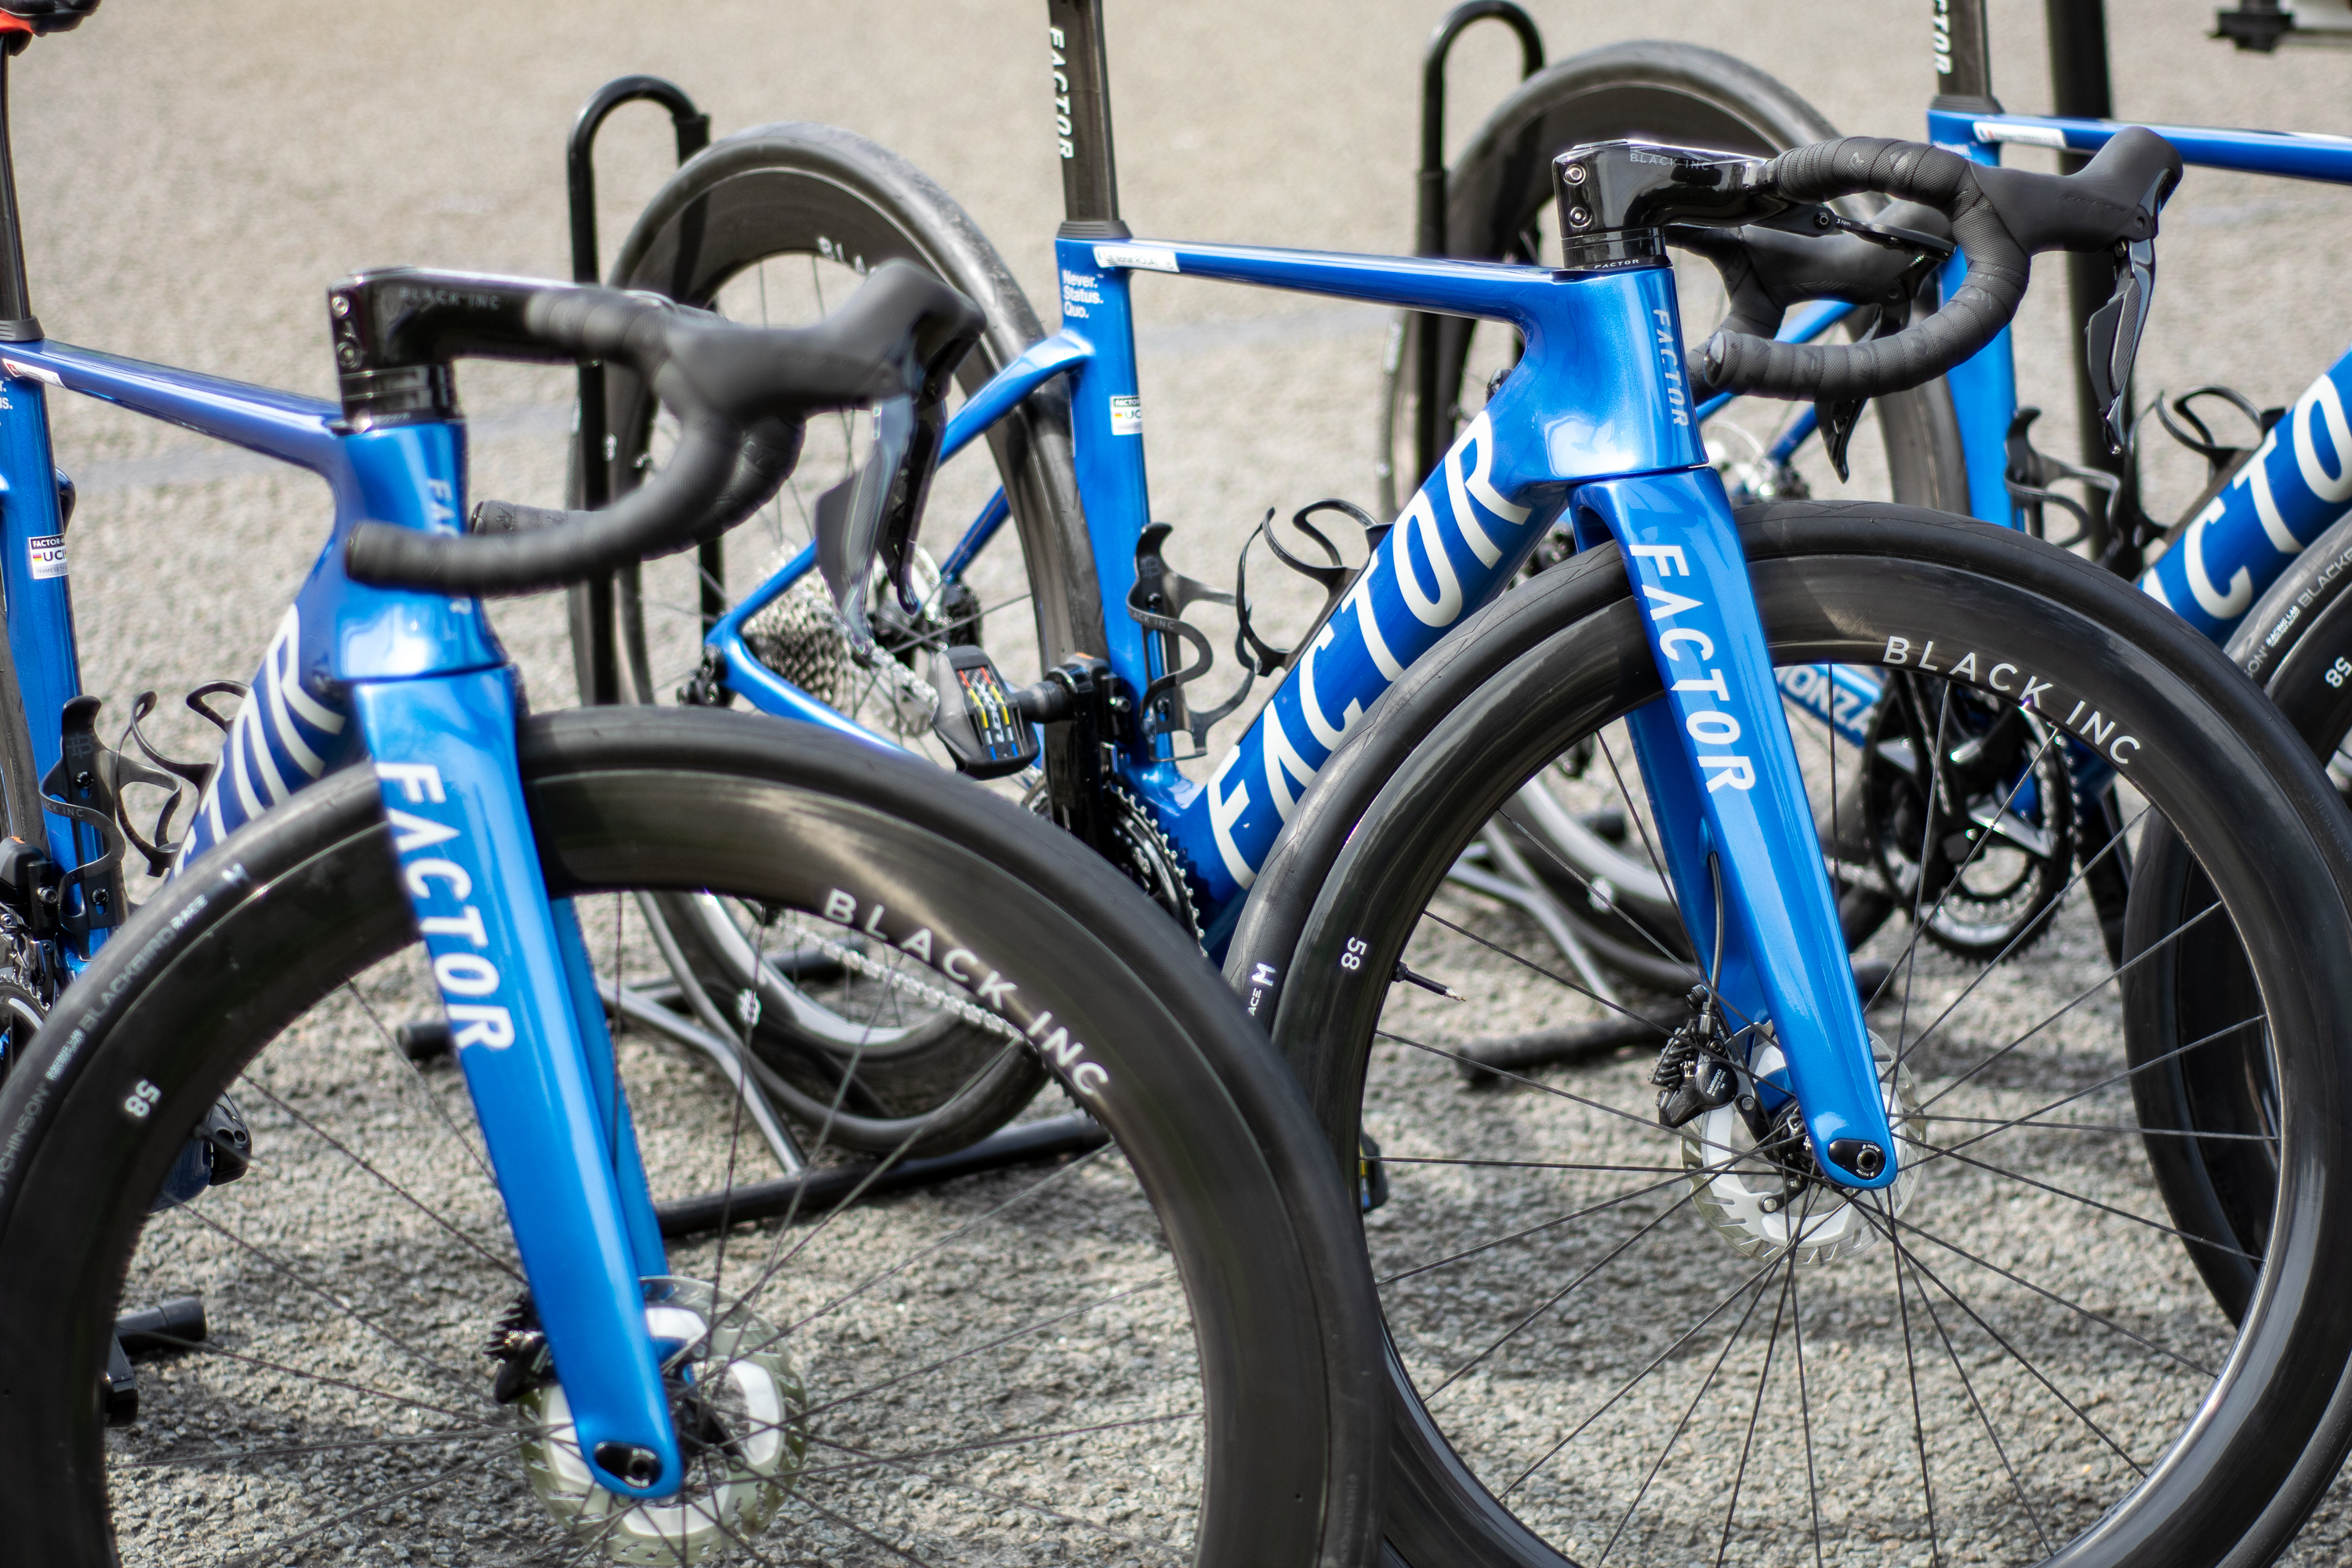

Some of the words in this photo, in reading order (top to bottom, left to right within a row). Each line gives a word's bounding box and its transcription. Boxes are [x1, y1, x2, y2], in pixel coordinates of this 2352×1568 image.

[1050, 26, 1075, 159] FACTOR
[1629, 154, 1678, 167] BLACK
[1686, 159, 1710, 171] INC
[1062, 270, 1098, 289] Never.
[1593, 259, 1640, 270] FACTOR
[399, 286, 460, 306] BLACK
[1063, 285, 1104, 304] Status.
[1063, 300, 1090, 318] Quo.
[1653, 309, 1690, 426] FACTOR
[43, 549, 65, 562] UCI
[1155, 618, 1174, 630] INC
[1206, 410, 1532, 891] FACTOR
[1628, 545, 1756, 793] FACTOR
[2325, 656, 2352, 688] 58
[972, 678, 1004, 743] LOOK
[1882, 635, 2053, 709] BLACK
[2065, 700, 2140, 764] INC
[63, 808, 84, 817] INC
[169, 894, 209, 931] RACE
[375, 762, 516, 1050] FACTOR
[1341, 936, 1367, 970] 58
[823, 888, 1018, 1010] BLACK
[1027, 1011, 1109, 1095] INC
[125, 1079, 162, 1117] 58
[1707, 1069, 1722, 1094] SHIMANO
